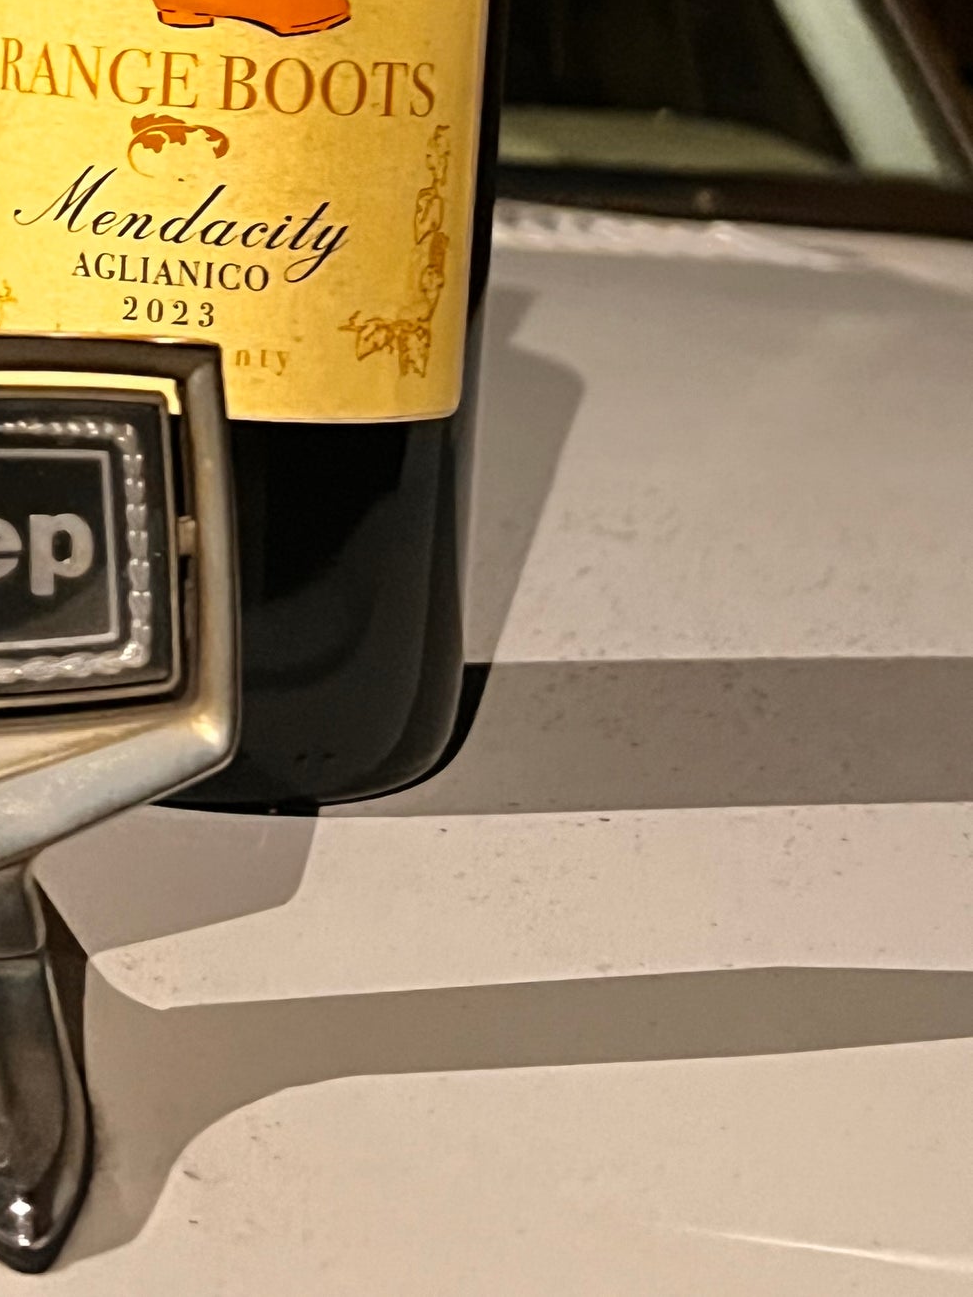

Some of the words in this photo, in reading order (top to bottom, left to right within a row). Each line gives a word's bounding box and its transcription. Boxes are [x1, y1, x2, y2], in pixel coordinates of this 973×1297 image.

[218, 54, 436, 118] BOOTS
[13, 164, 350, 283] Mendacity
[72, 252, 270, 292] AGLIANICO
[121, 296, 215, 328] 2023
[234, 348, 291, 377] nty
